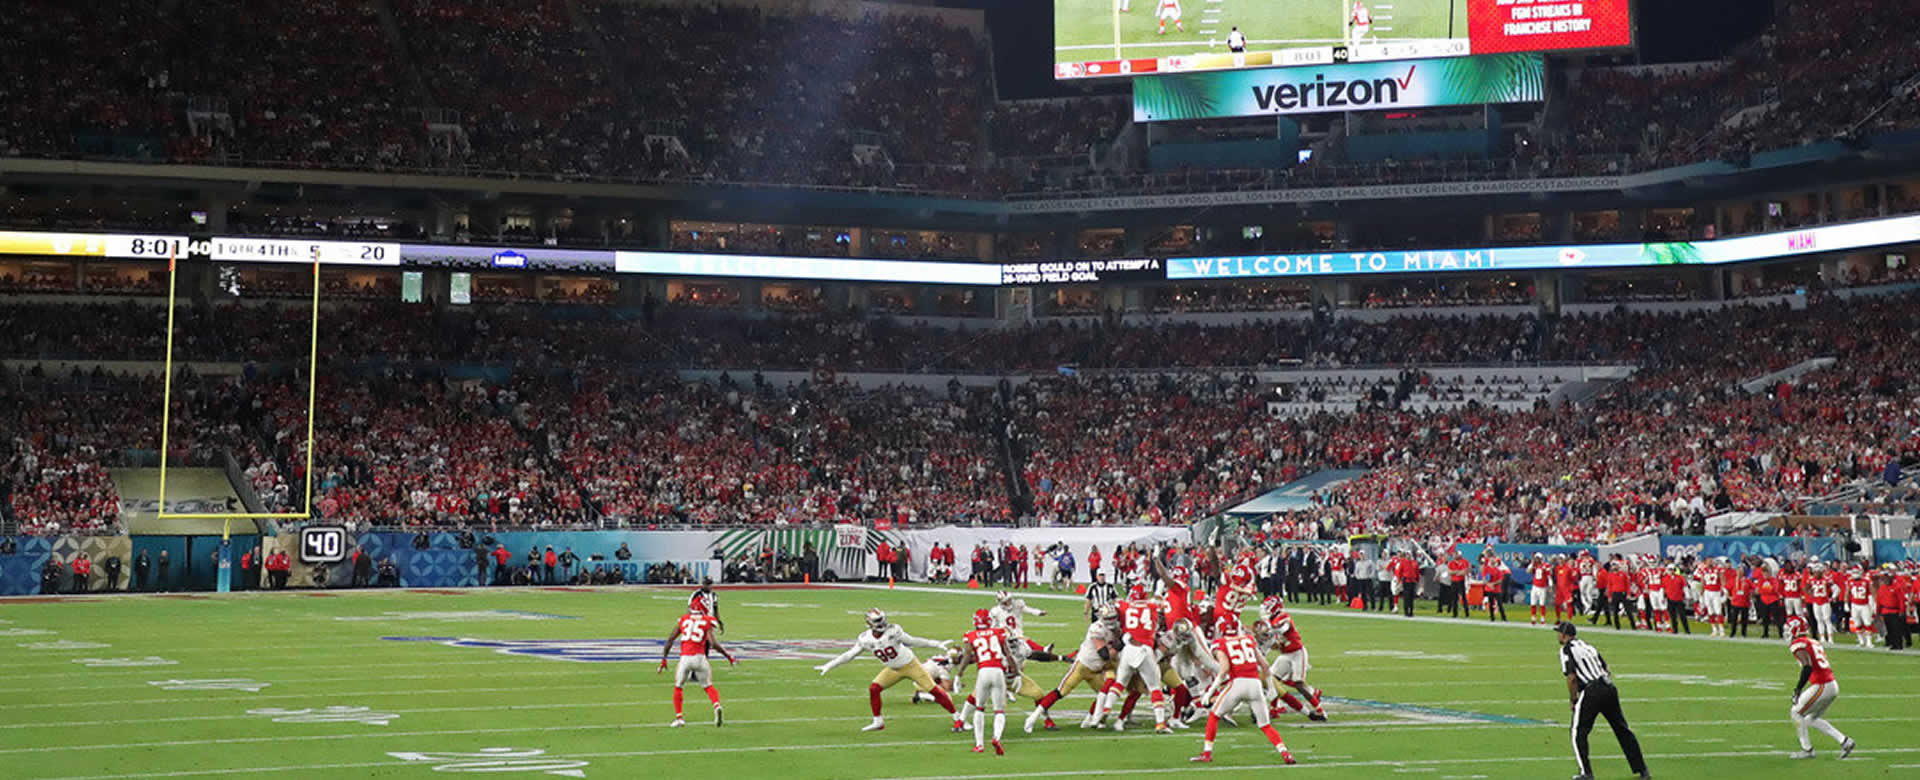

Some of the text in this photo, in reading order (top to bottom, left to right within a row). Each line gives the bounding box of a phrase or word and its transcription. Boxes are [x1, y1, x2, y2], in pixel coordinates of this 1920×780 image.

[1532, 4, 1571, 18] STREAKS
[1504, 18, 1592, 36] FRANCHISE HISTORY
[1333, 49, 1348, 60] 40
[1252, 73, 1398, 111] verizon
[131, 238, 210, 255] 8:01 40
[1788, 231, 1817, 251] MIAMI
[360, 244, 385, 261] 20
[1040, 262, 1073, 272] GOULD
[1075, 261, 1090, 271] ON
[1092, 260, 1105, 271] TO
[1106, 259, 1150, 271] ATTEMPT
[1151, 259, 1159, 269] A
[1193, 249, 1496, 276] WELCOME TO MIAMI
[1042, 272, 1069, 283] FIELD
[1071, 271, 1099, 282] GOAL
[308, 532, 340, 555] 40
[1783, 579, 1798, 592] 30
[1851, 585, 1868, 600] 42
[1221, 589, 1249, 612] 92
[1005, 615, 1017, 630] 9
[1124, 608, 1153, 630] 64
[680, 619, 707, 642] 35
[973, 636, 1003, 663] 24
[1225, 637, 1258, 665] 56
